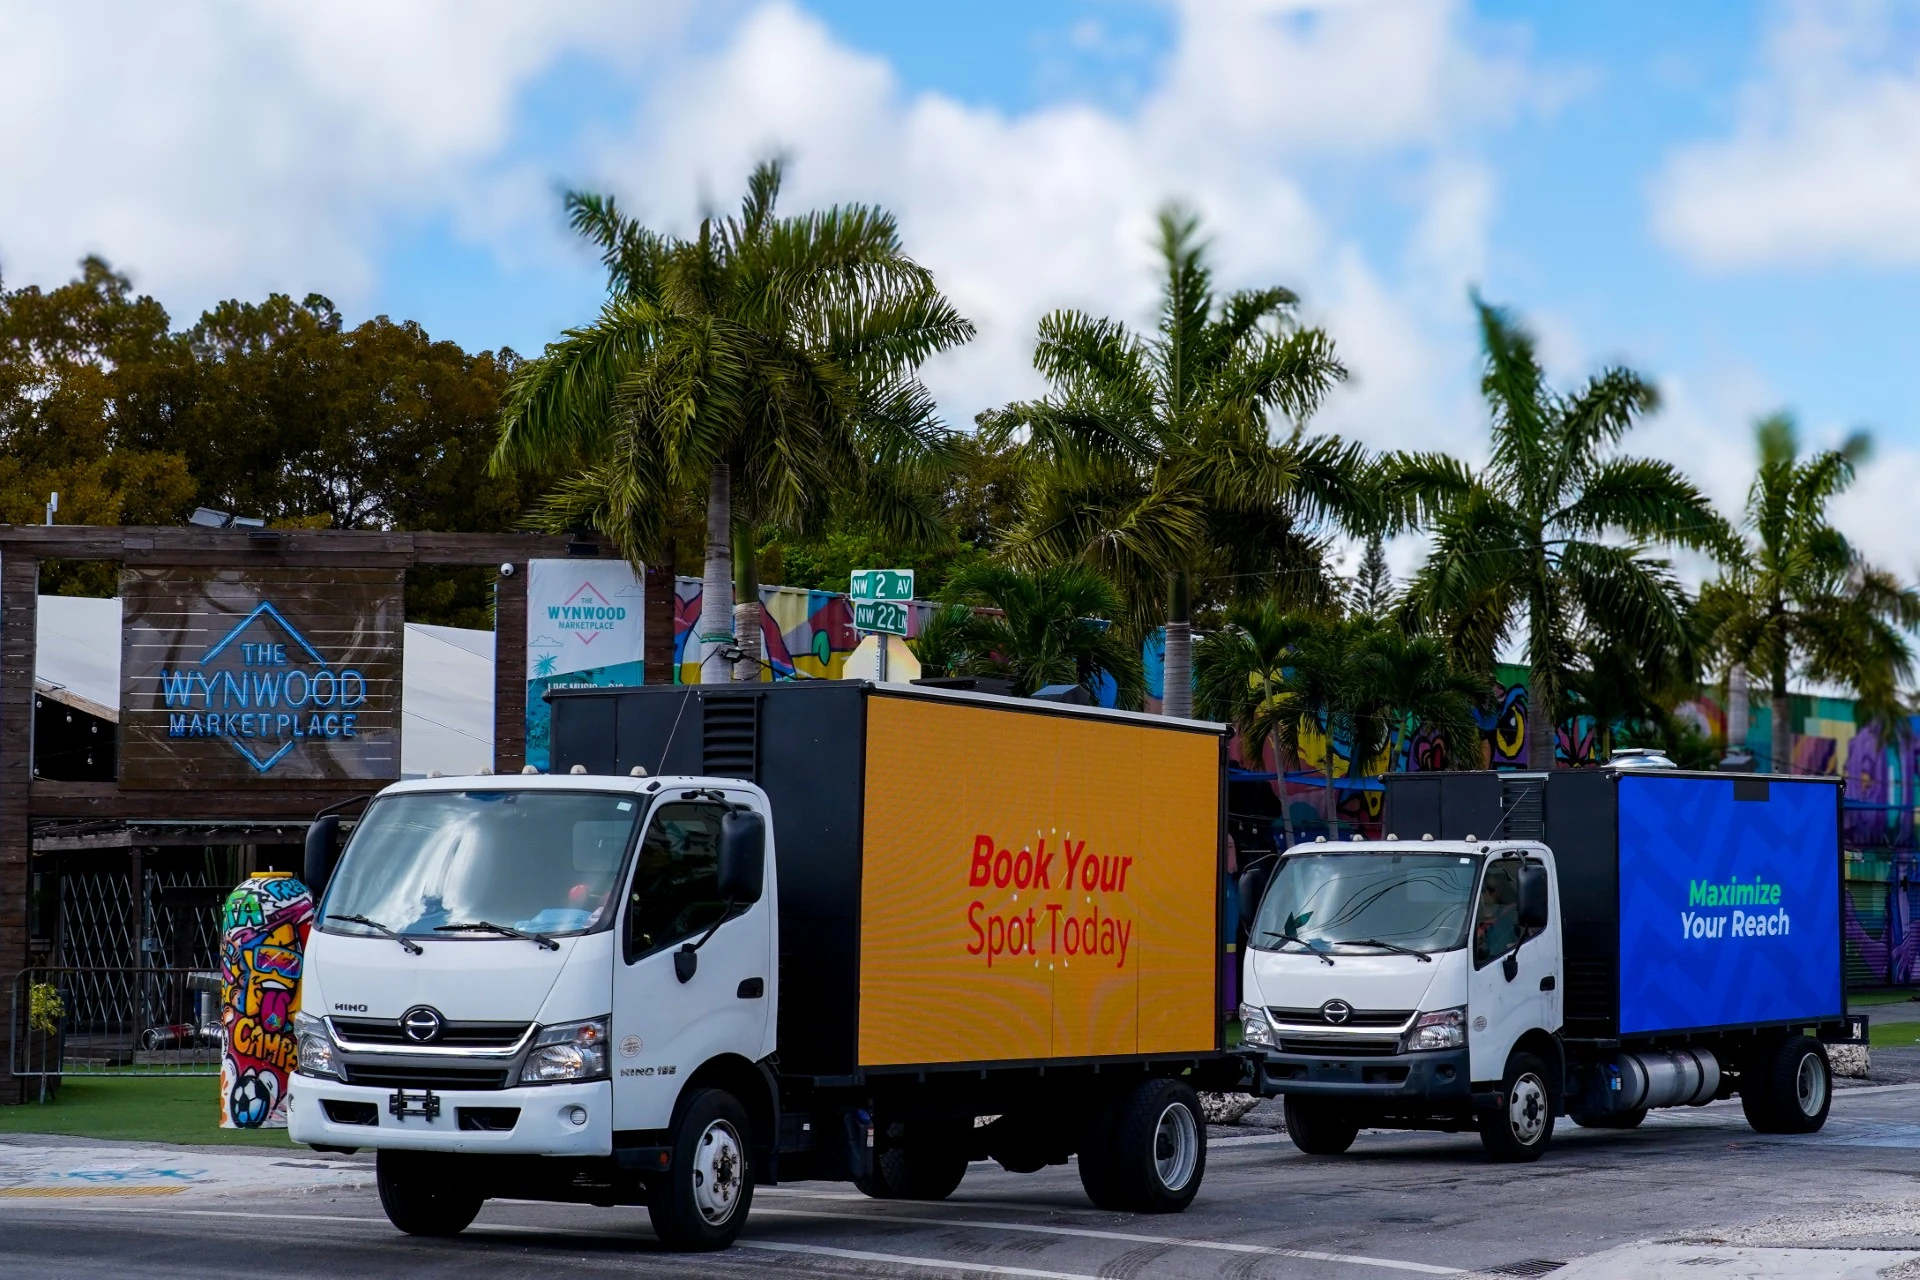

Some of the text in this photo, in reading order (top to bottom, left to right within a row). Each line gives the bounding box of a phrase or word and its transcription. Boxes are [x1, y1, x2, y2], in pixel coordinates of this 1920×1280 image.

[853, 573, 911, 597] NW 2 AV
[548, 606, 626, 620] WYNWOOD
[858, 605, 907, 630] NW 22 LN
[559, 622, 614, 630] MARKETPLACE
[241, 643, 288, 666] THE
[161, 669, 368, 709] WYNWOOD
[169, 713, 357, 737] MARKETPLACE
[969, 834, 1133, 892] Book Your
[1689, 875, 1782, 906] Maximize
[967, 900, 1132, 968] Spot Today
[1681, 907, 1790, 939] Your Reach
[335, 1003, 368, 1012] HINO
[621, 1067, 654, 1076] HINO
